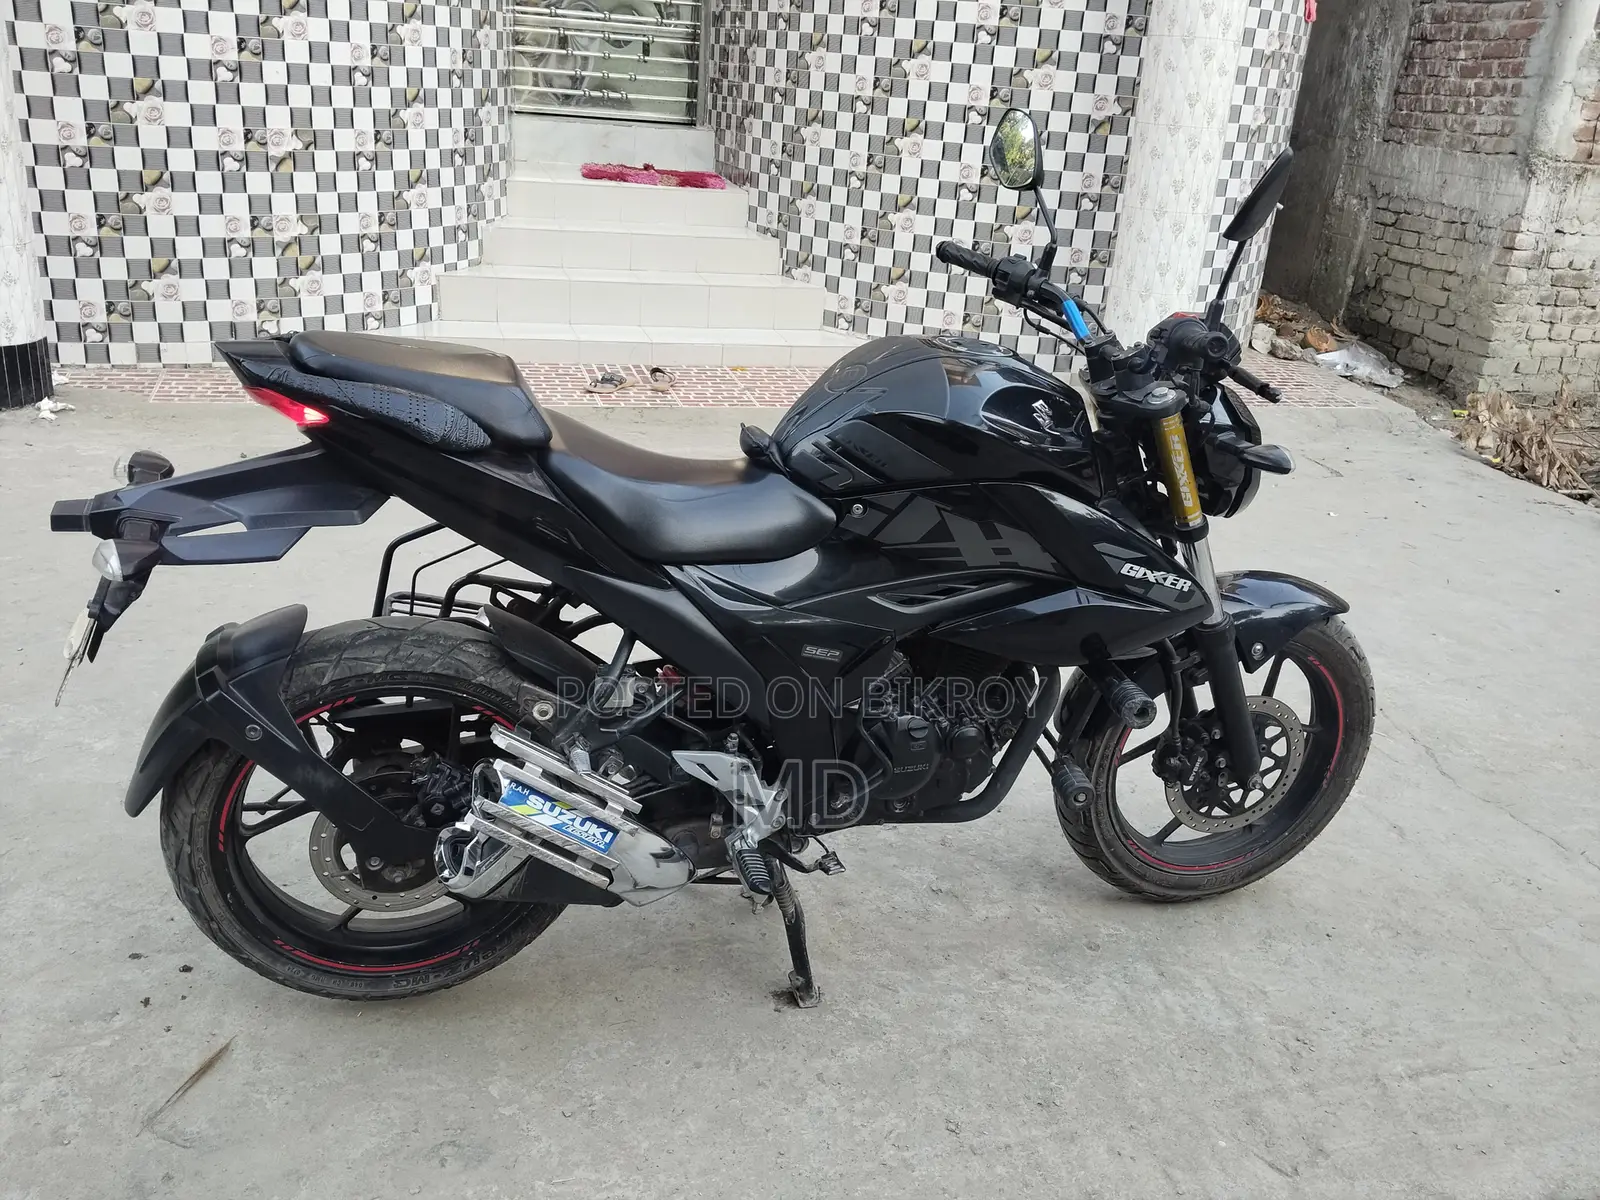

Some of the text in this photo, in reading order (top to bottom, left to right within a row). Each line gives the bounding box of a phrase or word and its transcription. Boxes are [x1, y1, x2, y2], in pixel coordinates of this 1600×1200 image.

[1120, 562, 1192, 592] GIXXER
[804, 646, 840, 657] SEP
[526, 794, 614, 844] SUZUKI
